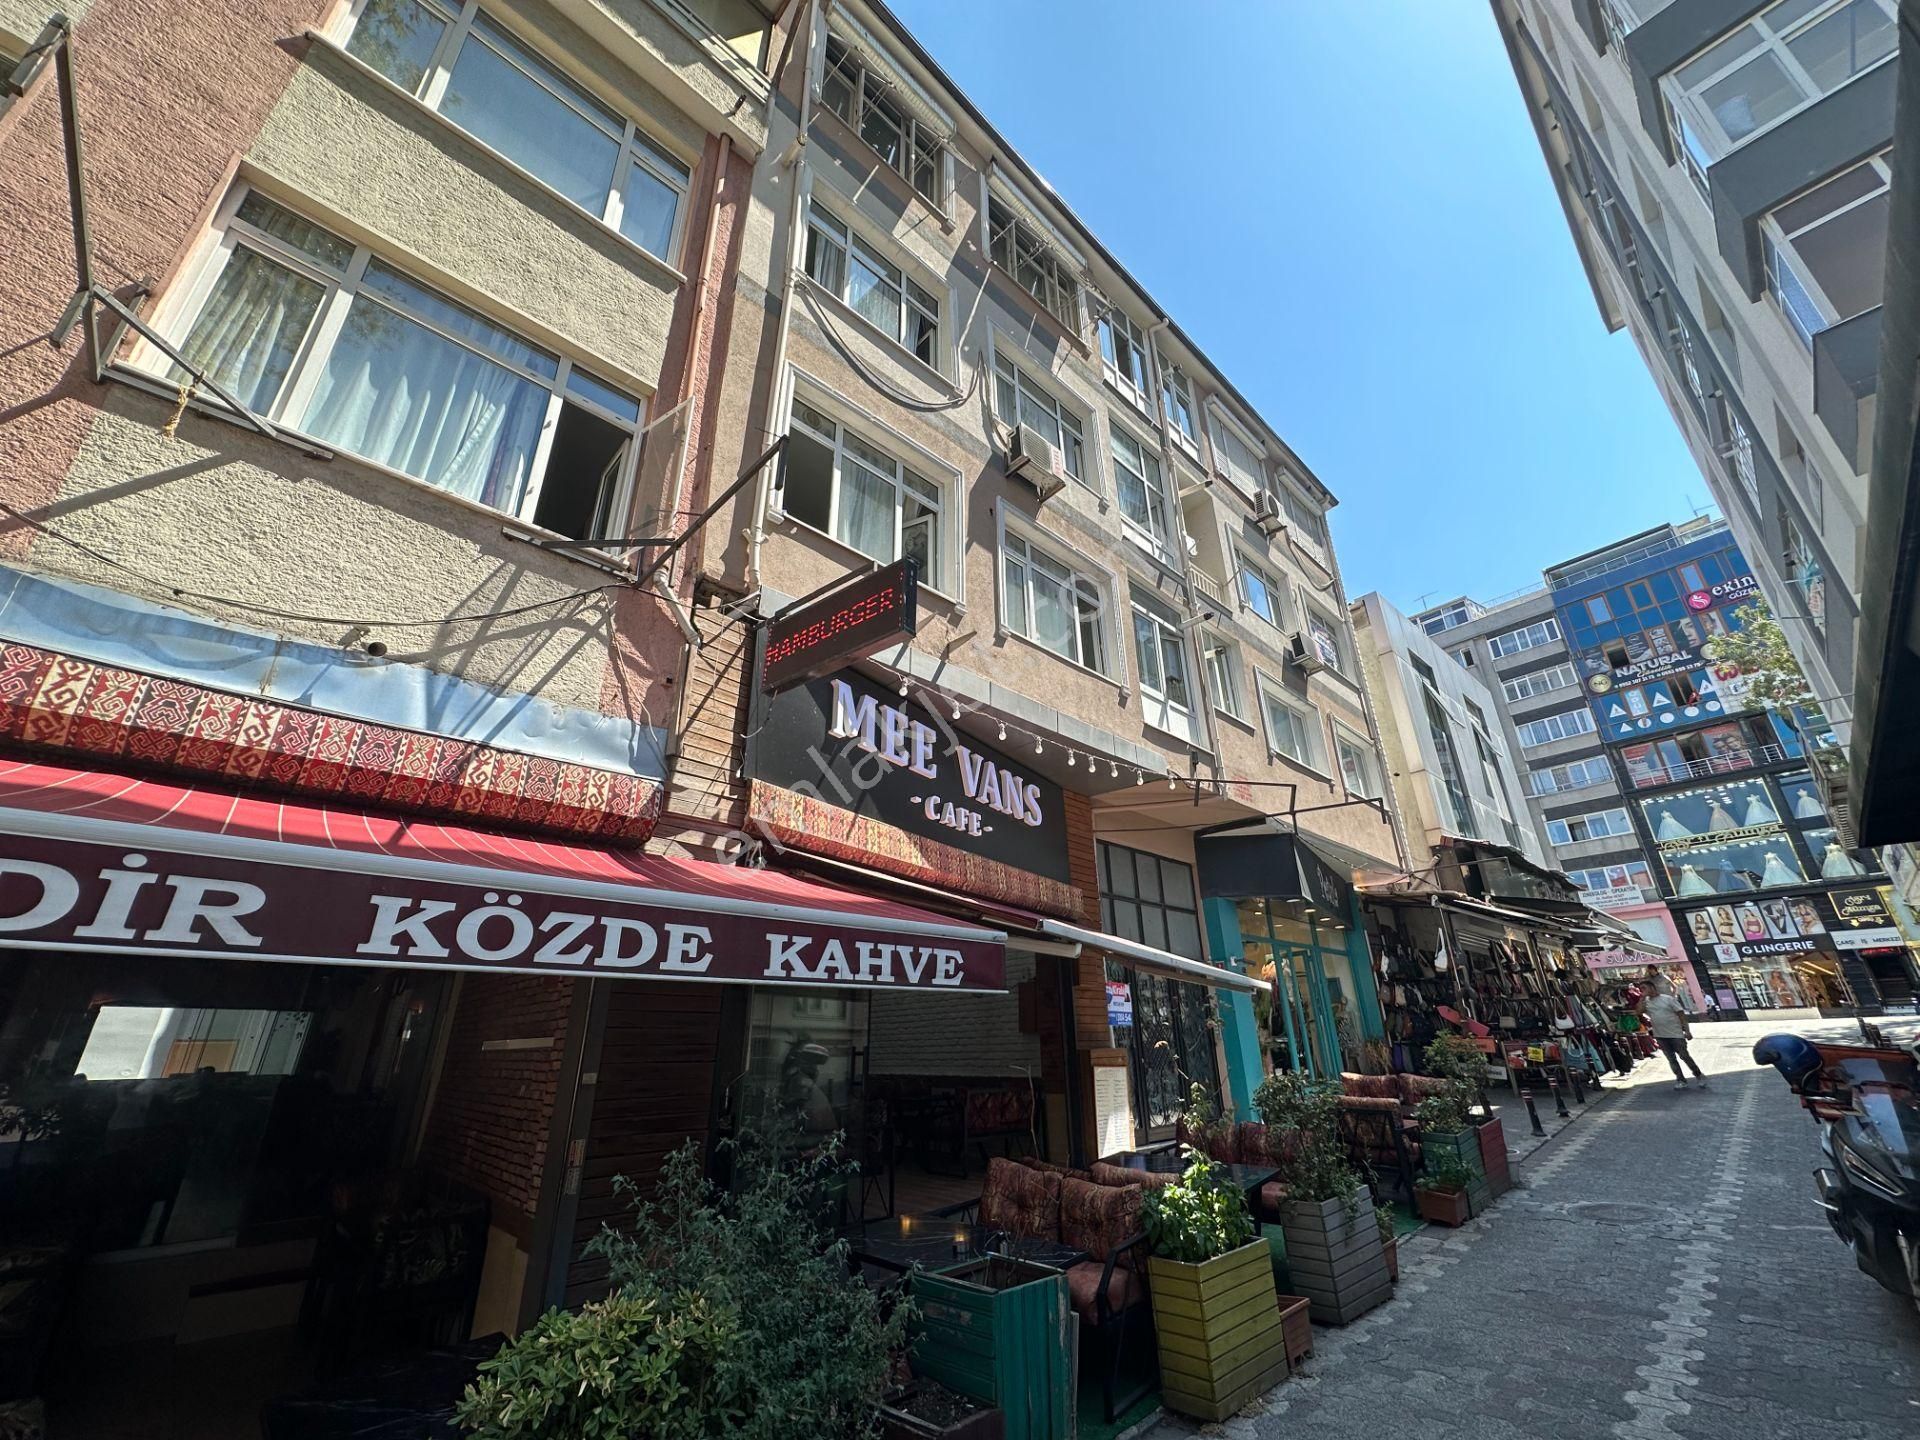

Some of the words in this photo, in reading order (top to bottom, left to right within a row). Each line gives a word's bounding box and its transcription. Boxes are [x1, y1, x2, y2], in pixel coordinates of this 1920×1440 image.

[765, 588, 894, 667] HAMBURGER
[1615, 651, 1692, 678] NATURAL
[828, 679, 938, 780] MEE
[956, 745, 1043, 828] VANS
[355, 891, 713, 972] KÖZDE
[763, 932, 965, 986] KAHVE
[1741, 945, 1753, 955] G
[1754, 940, 1816, 954] LINGERIE
